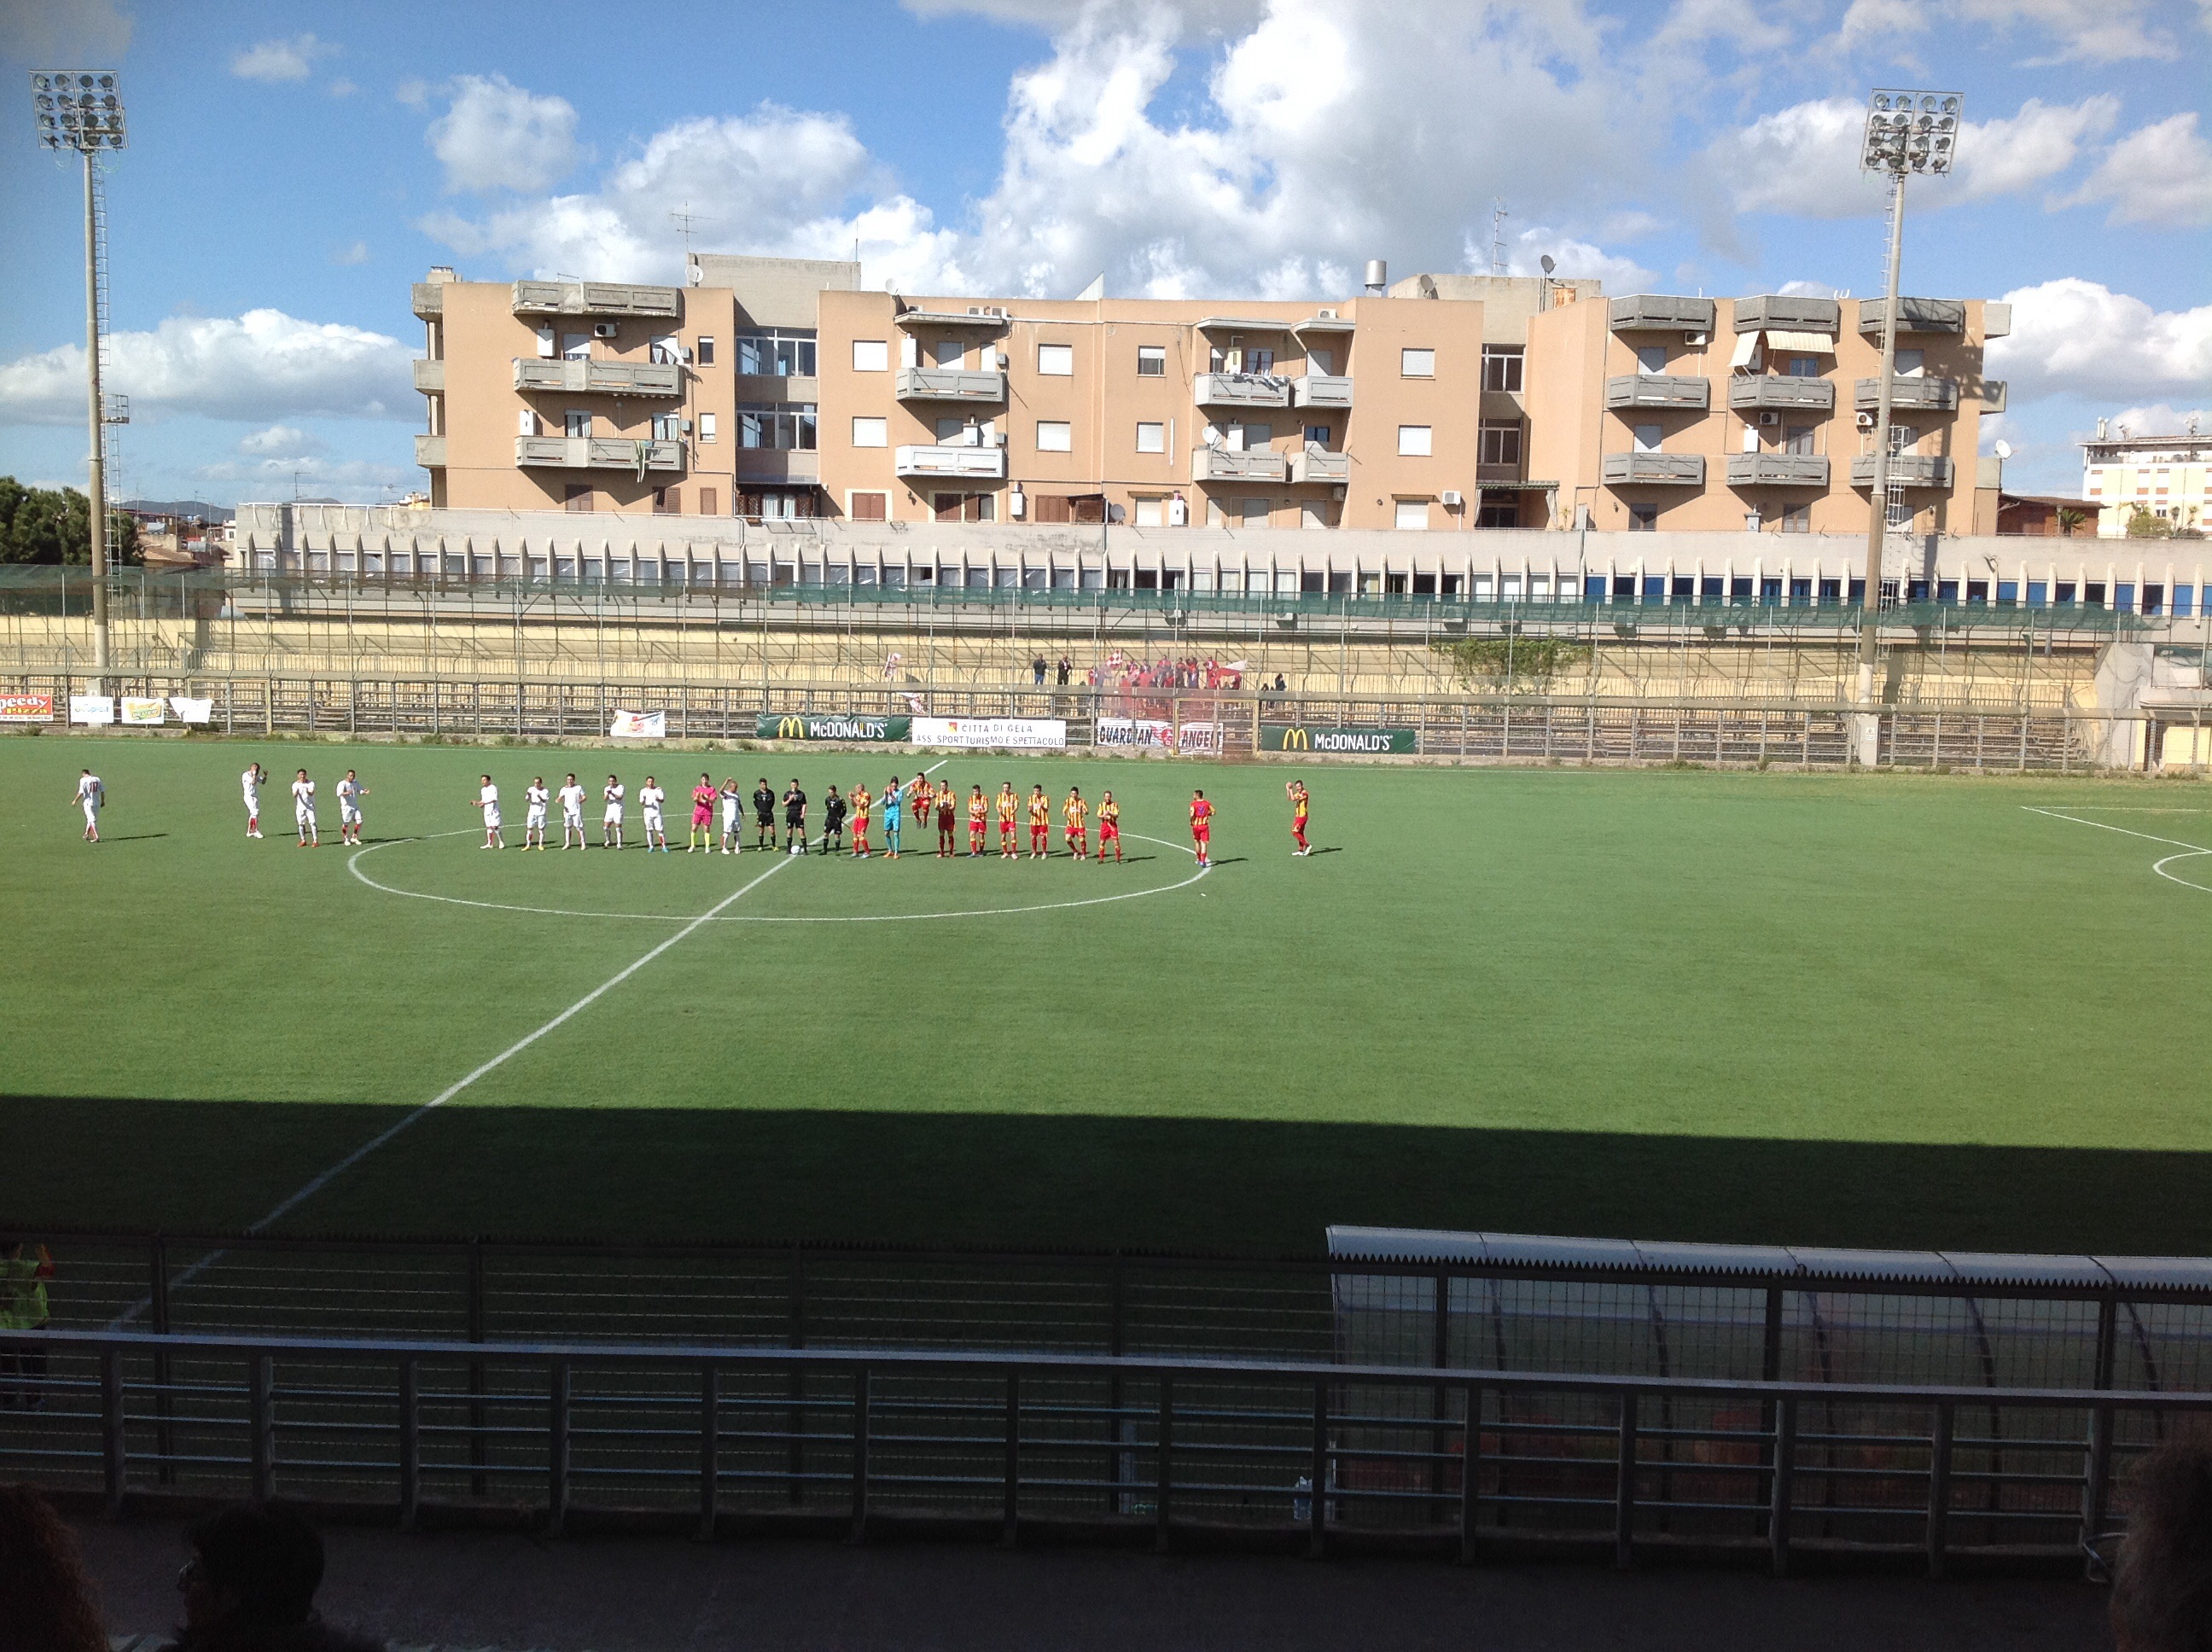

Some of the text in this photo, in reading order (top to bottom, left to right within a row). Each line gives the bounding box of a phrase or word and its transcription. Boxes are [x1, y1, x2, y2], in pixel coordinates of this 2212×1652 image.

[1008, 724, 1033, 733] GELA
[937, 735, 963, 744] SPORT
[965, 736, 1004, 745] TURISMO
[1005, 736, 1010, 745] E
[1012, 736, 1064, 746] SPETTACOLO
[1099, 725, 1152, 746] GUARDIAN
